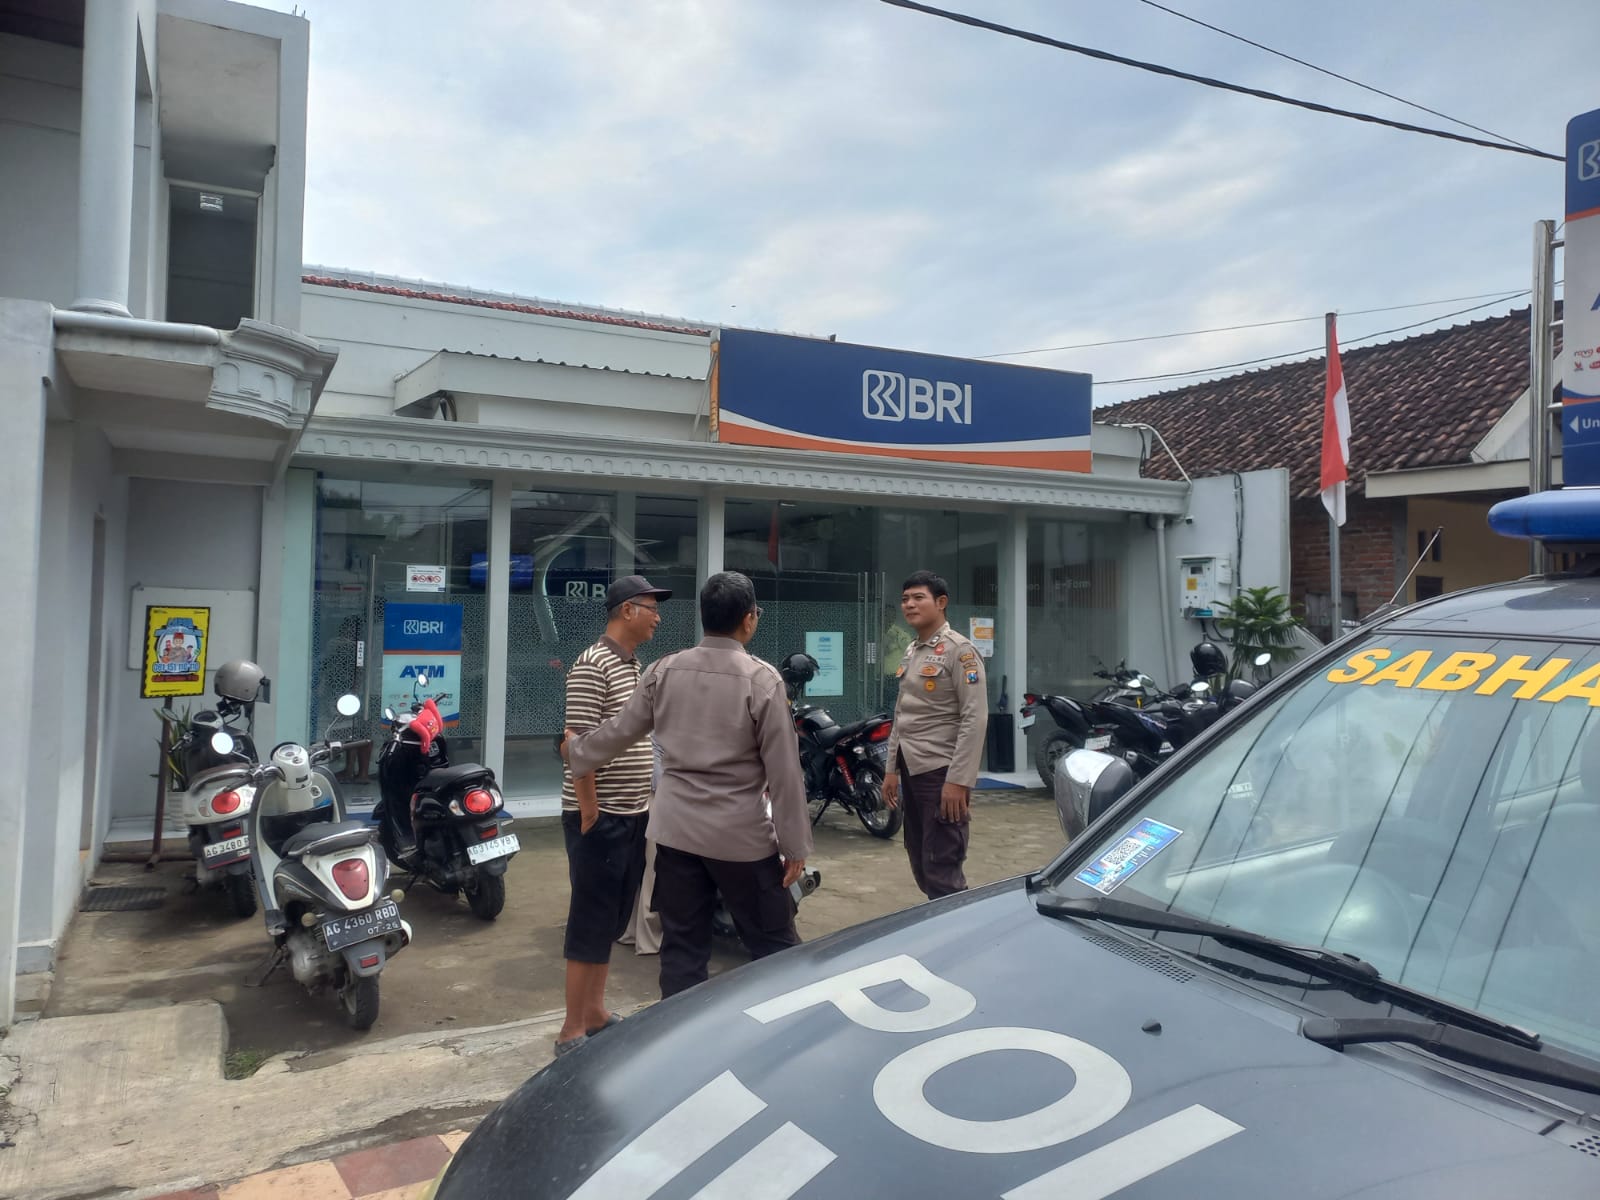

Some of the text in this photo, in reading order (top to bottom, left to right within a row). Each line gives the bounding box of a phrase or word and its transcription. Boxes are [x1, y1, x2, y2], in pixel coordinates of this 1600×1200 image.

[909, 378, 972, 425] BRI
[419, 621, 444, 634] BRI
[400, 665, 445, 678] ATM
[344, 913, 373, 930] 4360
[374, 905, 397, 921] RBD
